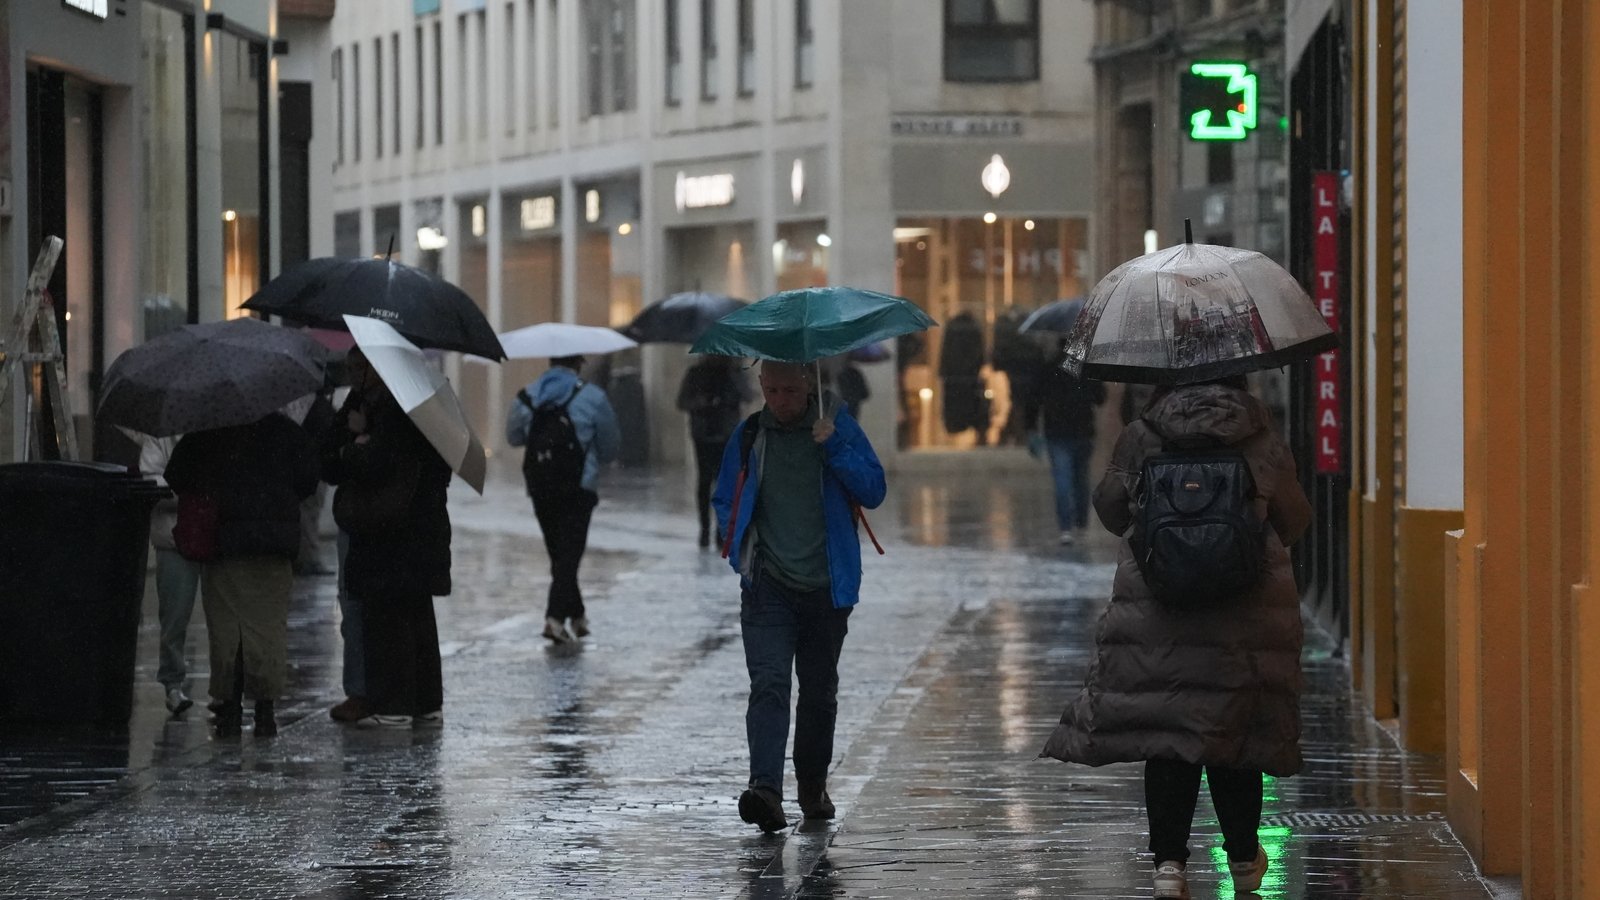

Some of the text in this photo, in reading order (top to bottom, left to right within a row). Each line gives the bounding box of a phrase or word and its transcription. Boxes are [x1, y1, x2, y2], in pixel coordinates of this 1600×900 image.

[1184, 271, 1229, 288] LONDON
[1318, 188, 1337, 455] LA TETRAL
